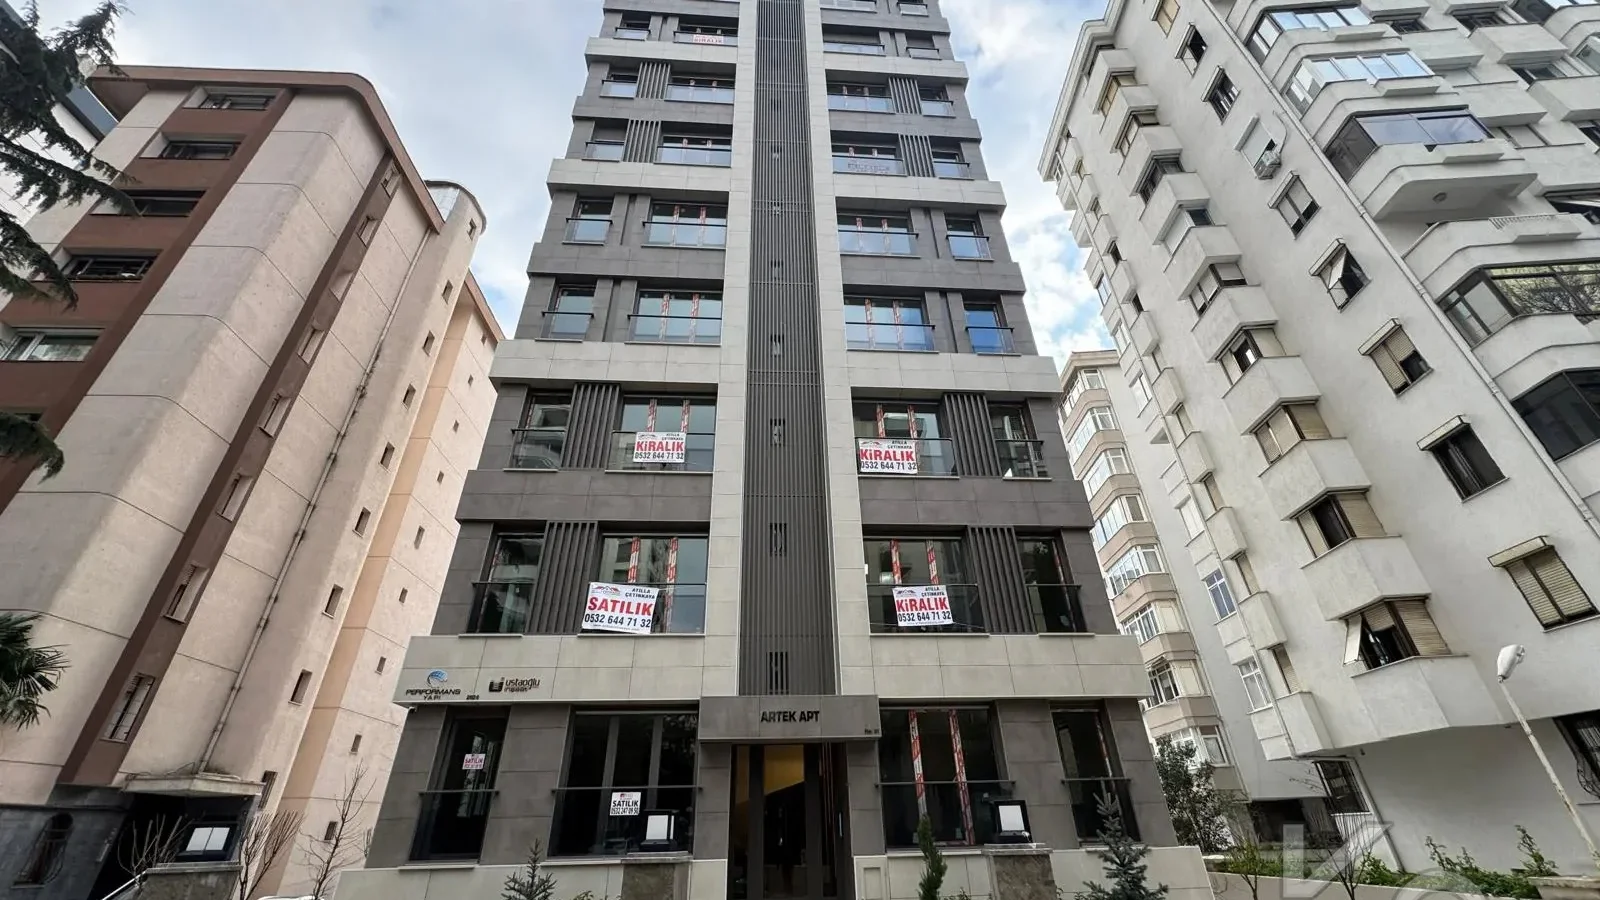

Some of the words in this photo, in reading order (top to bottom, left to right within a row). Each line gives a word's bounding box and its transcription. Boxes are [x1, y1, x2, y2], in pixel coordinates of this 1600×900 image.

[676, 452, 683, 460] 32
[861, 461, 878, 469] 0532
[880, 462, 894, 470] 644
[896, 462, 905, 470] 71
[907, 462, 916, 470] 32
[588, 597, 654, 616] SATILIK
[584, 613, 605, 623] 0532
[607, 615, 624, 626] 644
[627, 617, 638, 627] 71
[640, 618, 651, 628] 32
[898, 612, 915, 622] 0532
[917, 612, 930, 621] 644
[931, 611, 940, 620] 71
[942, 610, 951, 620] 32
[405, 688, 461, 696] PERFORMANS
[761, 711, 796, 722] ARTEK
[798, 711, 820, 722] APT
